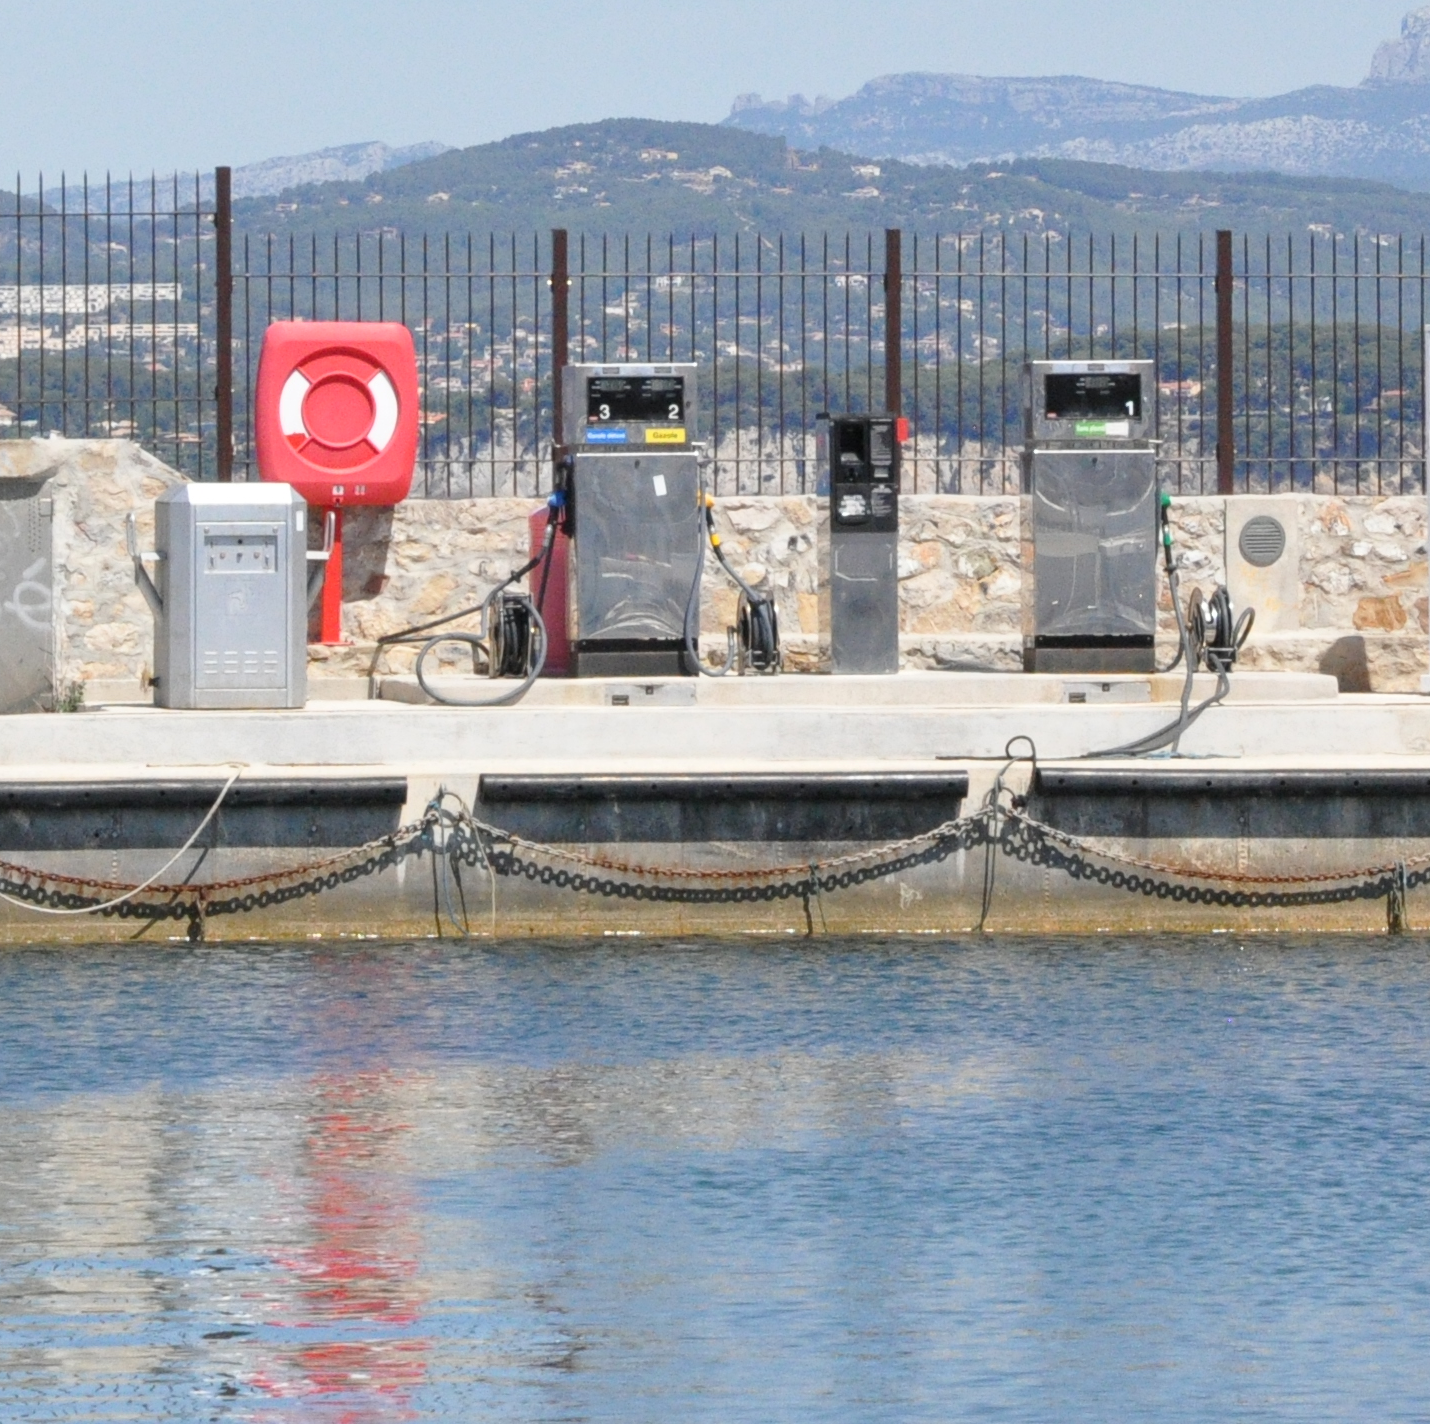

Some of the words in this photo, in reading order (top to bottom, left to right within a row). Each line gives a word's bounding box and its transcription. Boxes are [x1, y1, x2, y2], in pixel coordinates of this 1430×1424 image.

[599, 404, 610, 420] 3
[668, 404, 679, 419] 2
[1125, 400, 1134, 416] 1
